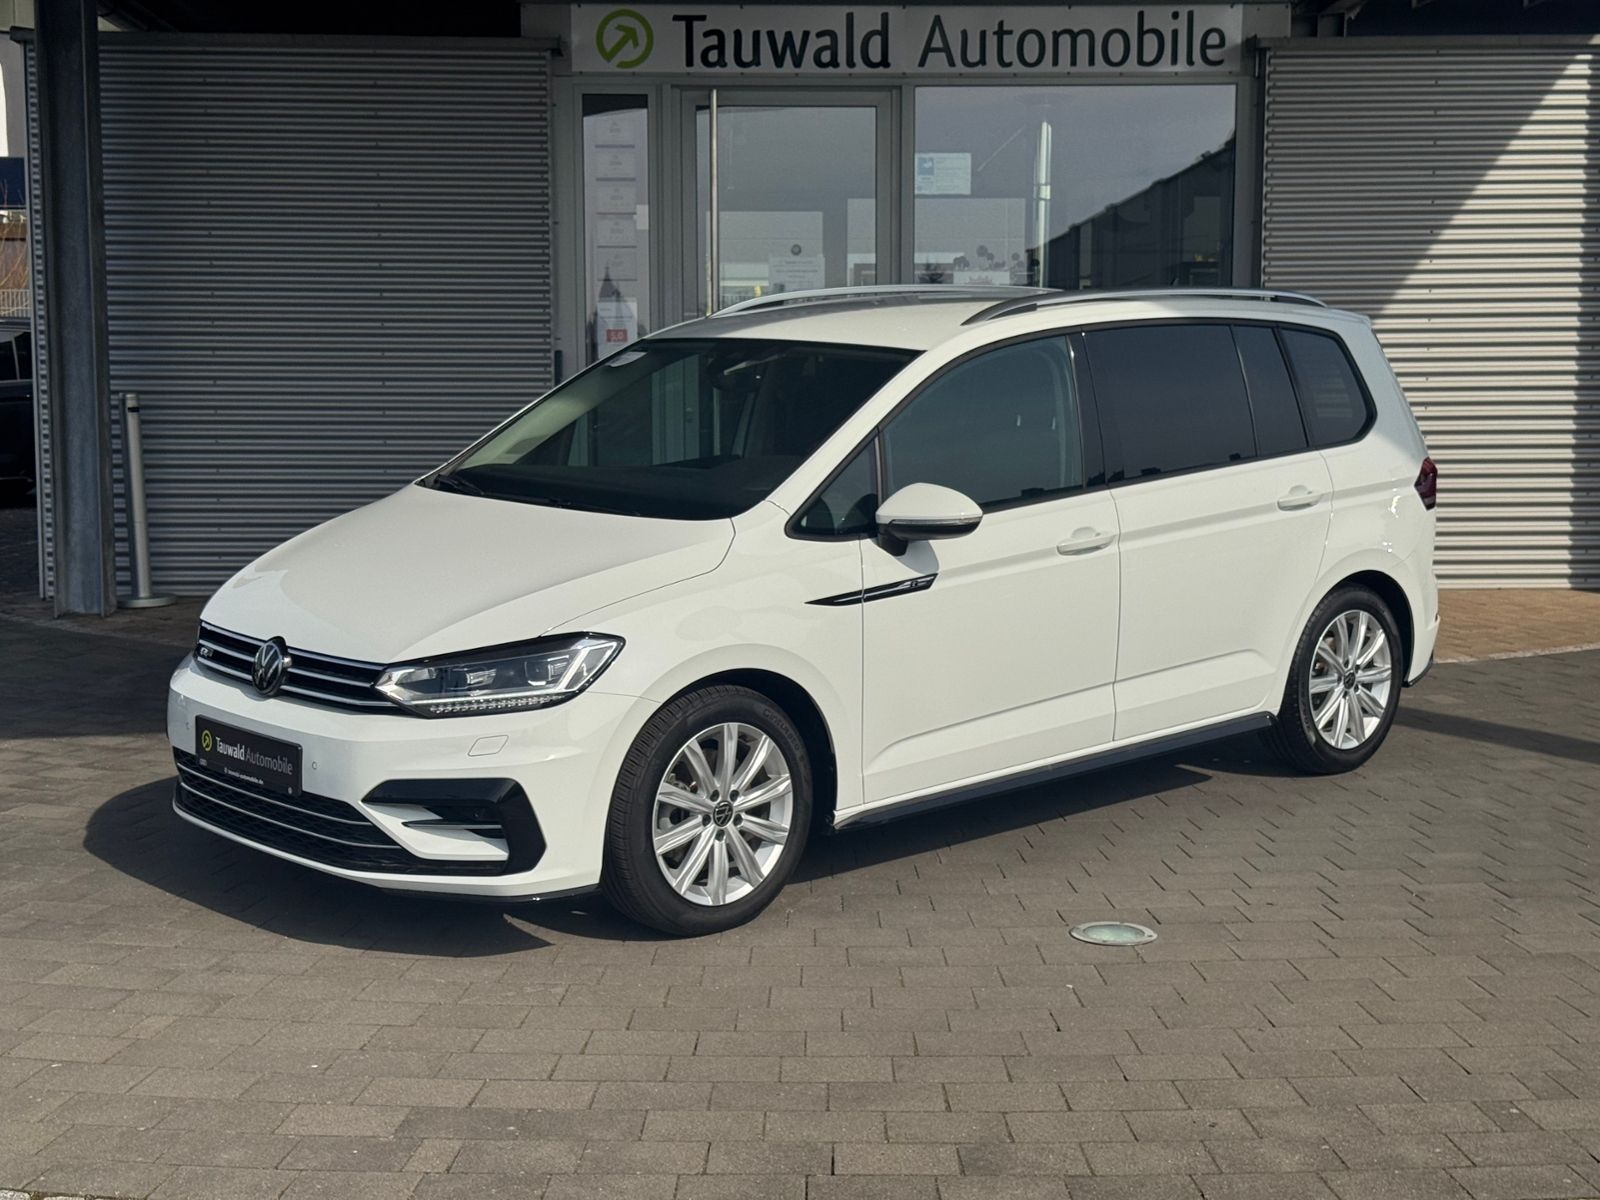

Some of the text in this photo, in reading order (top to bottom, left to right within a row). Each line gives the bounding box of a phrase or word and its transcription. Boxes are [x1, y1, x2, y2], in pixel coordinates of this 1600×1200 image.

[671, 10, 1227, 69] Tauwald Automobile
[215, 736, 293, 775] Tauwald Automobile
